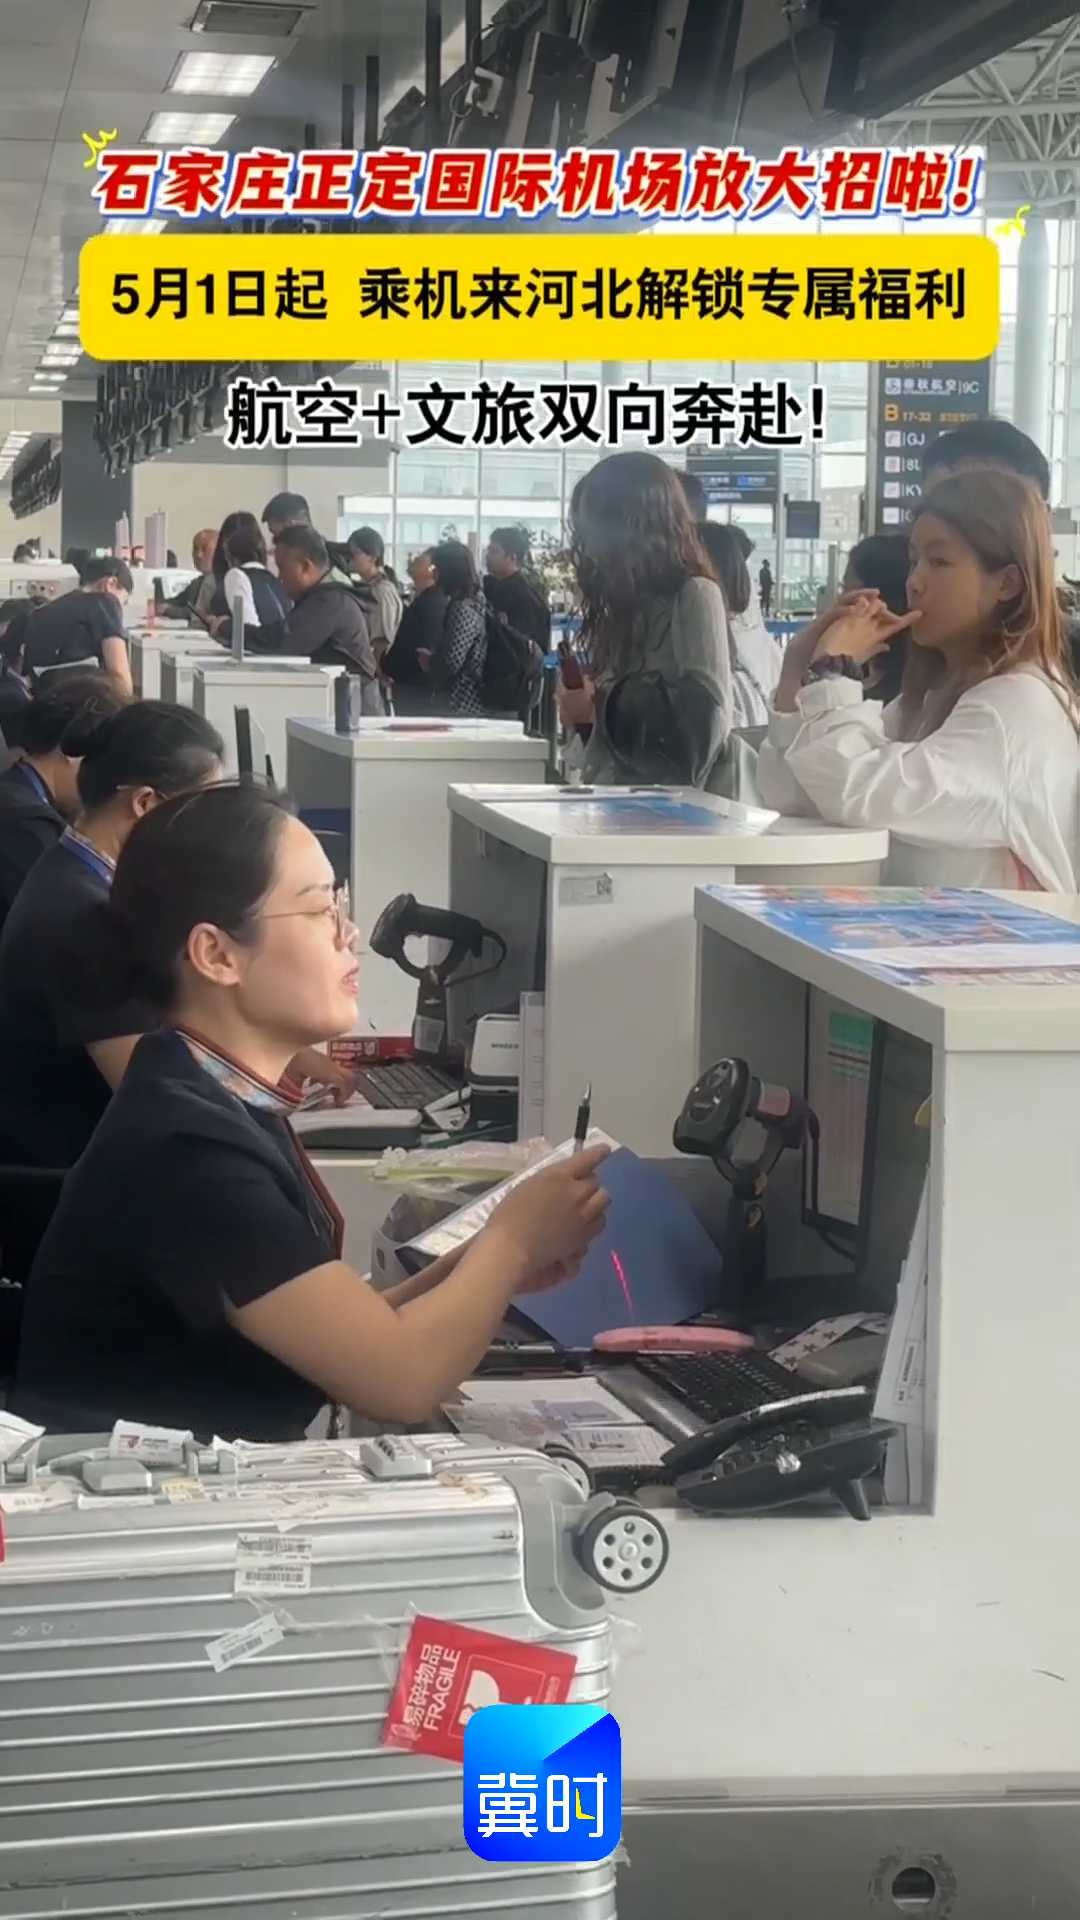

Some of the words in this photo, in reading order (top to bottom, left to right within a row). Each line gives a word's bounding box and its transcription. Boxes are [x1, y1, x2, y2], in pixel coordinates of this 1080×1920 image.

[884, 404, 899, 422] B
[906, 432, 926, 446] GJ
[402, 1643, 444, 1728] 易碎物品
[422, 1647, 462, 1731] FRAGILE
